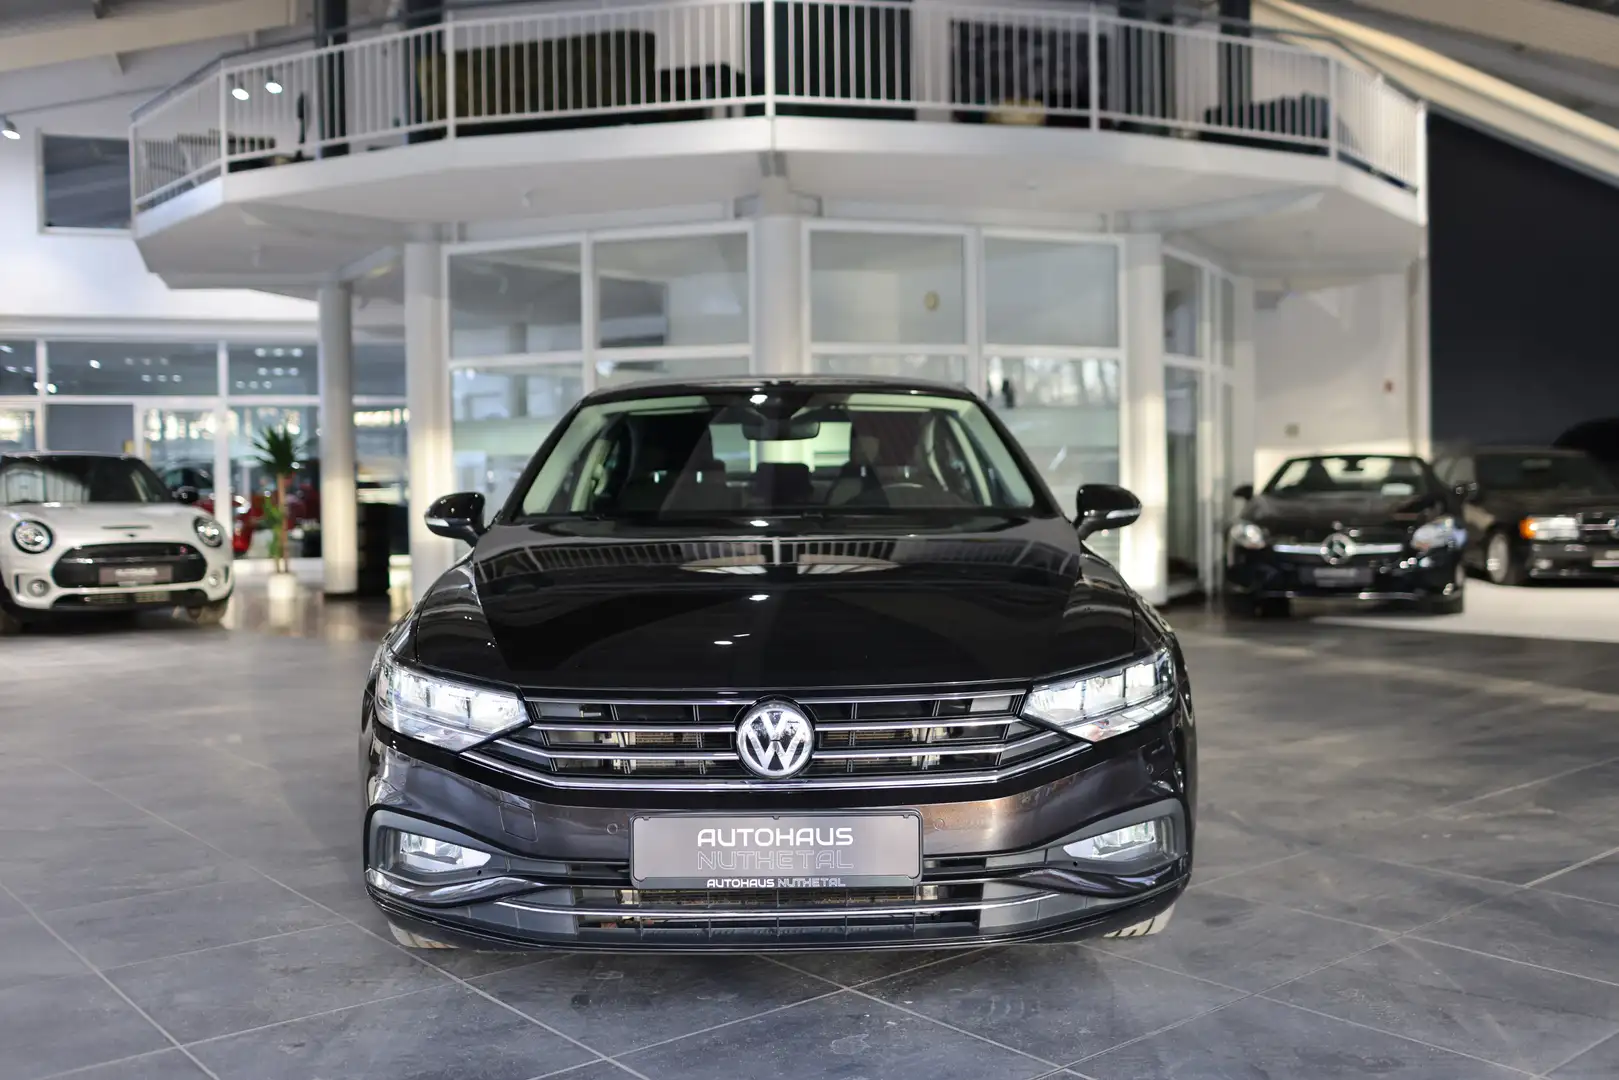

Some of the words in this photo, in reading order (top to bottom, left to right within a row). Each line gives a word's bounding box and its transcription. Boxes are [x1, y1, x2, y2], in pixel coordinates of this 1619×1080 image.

[697, 827, 854, 847] AUTOHAUS
[697, 850, 854, 870] NUTHETAL
[706, 879, 775, 888] AUTOHAUS
[777, 878, 846, 887] NUTHETAL
